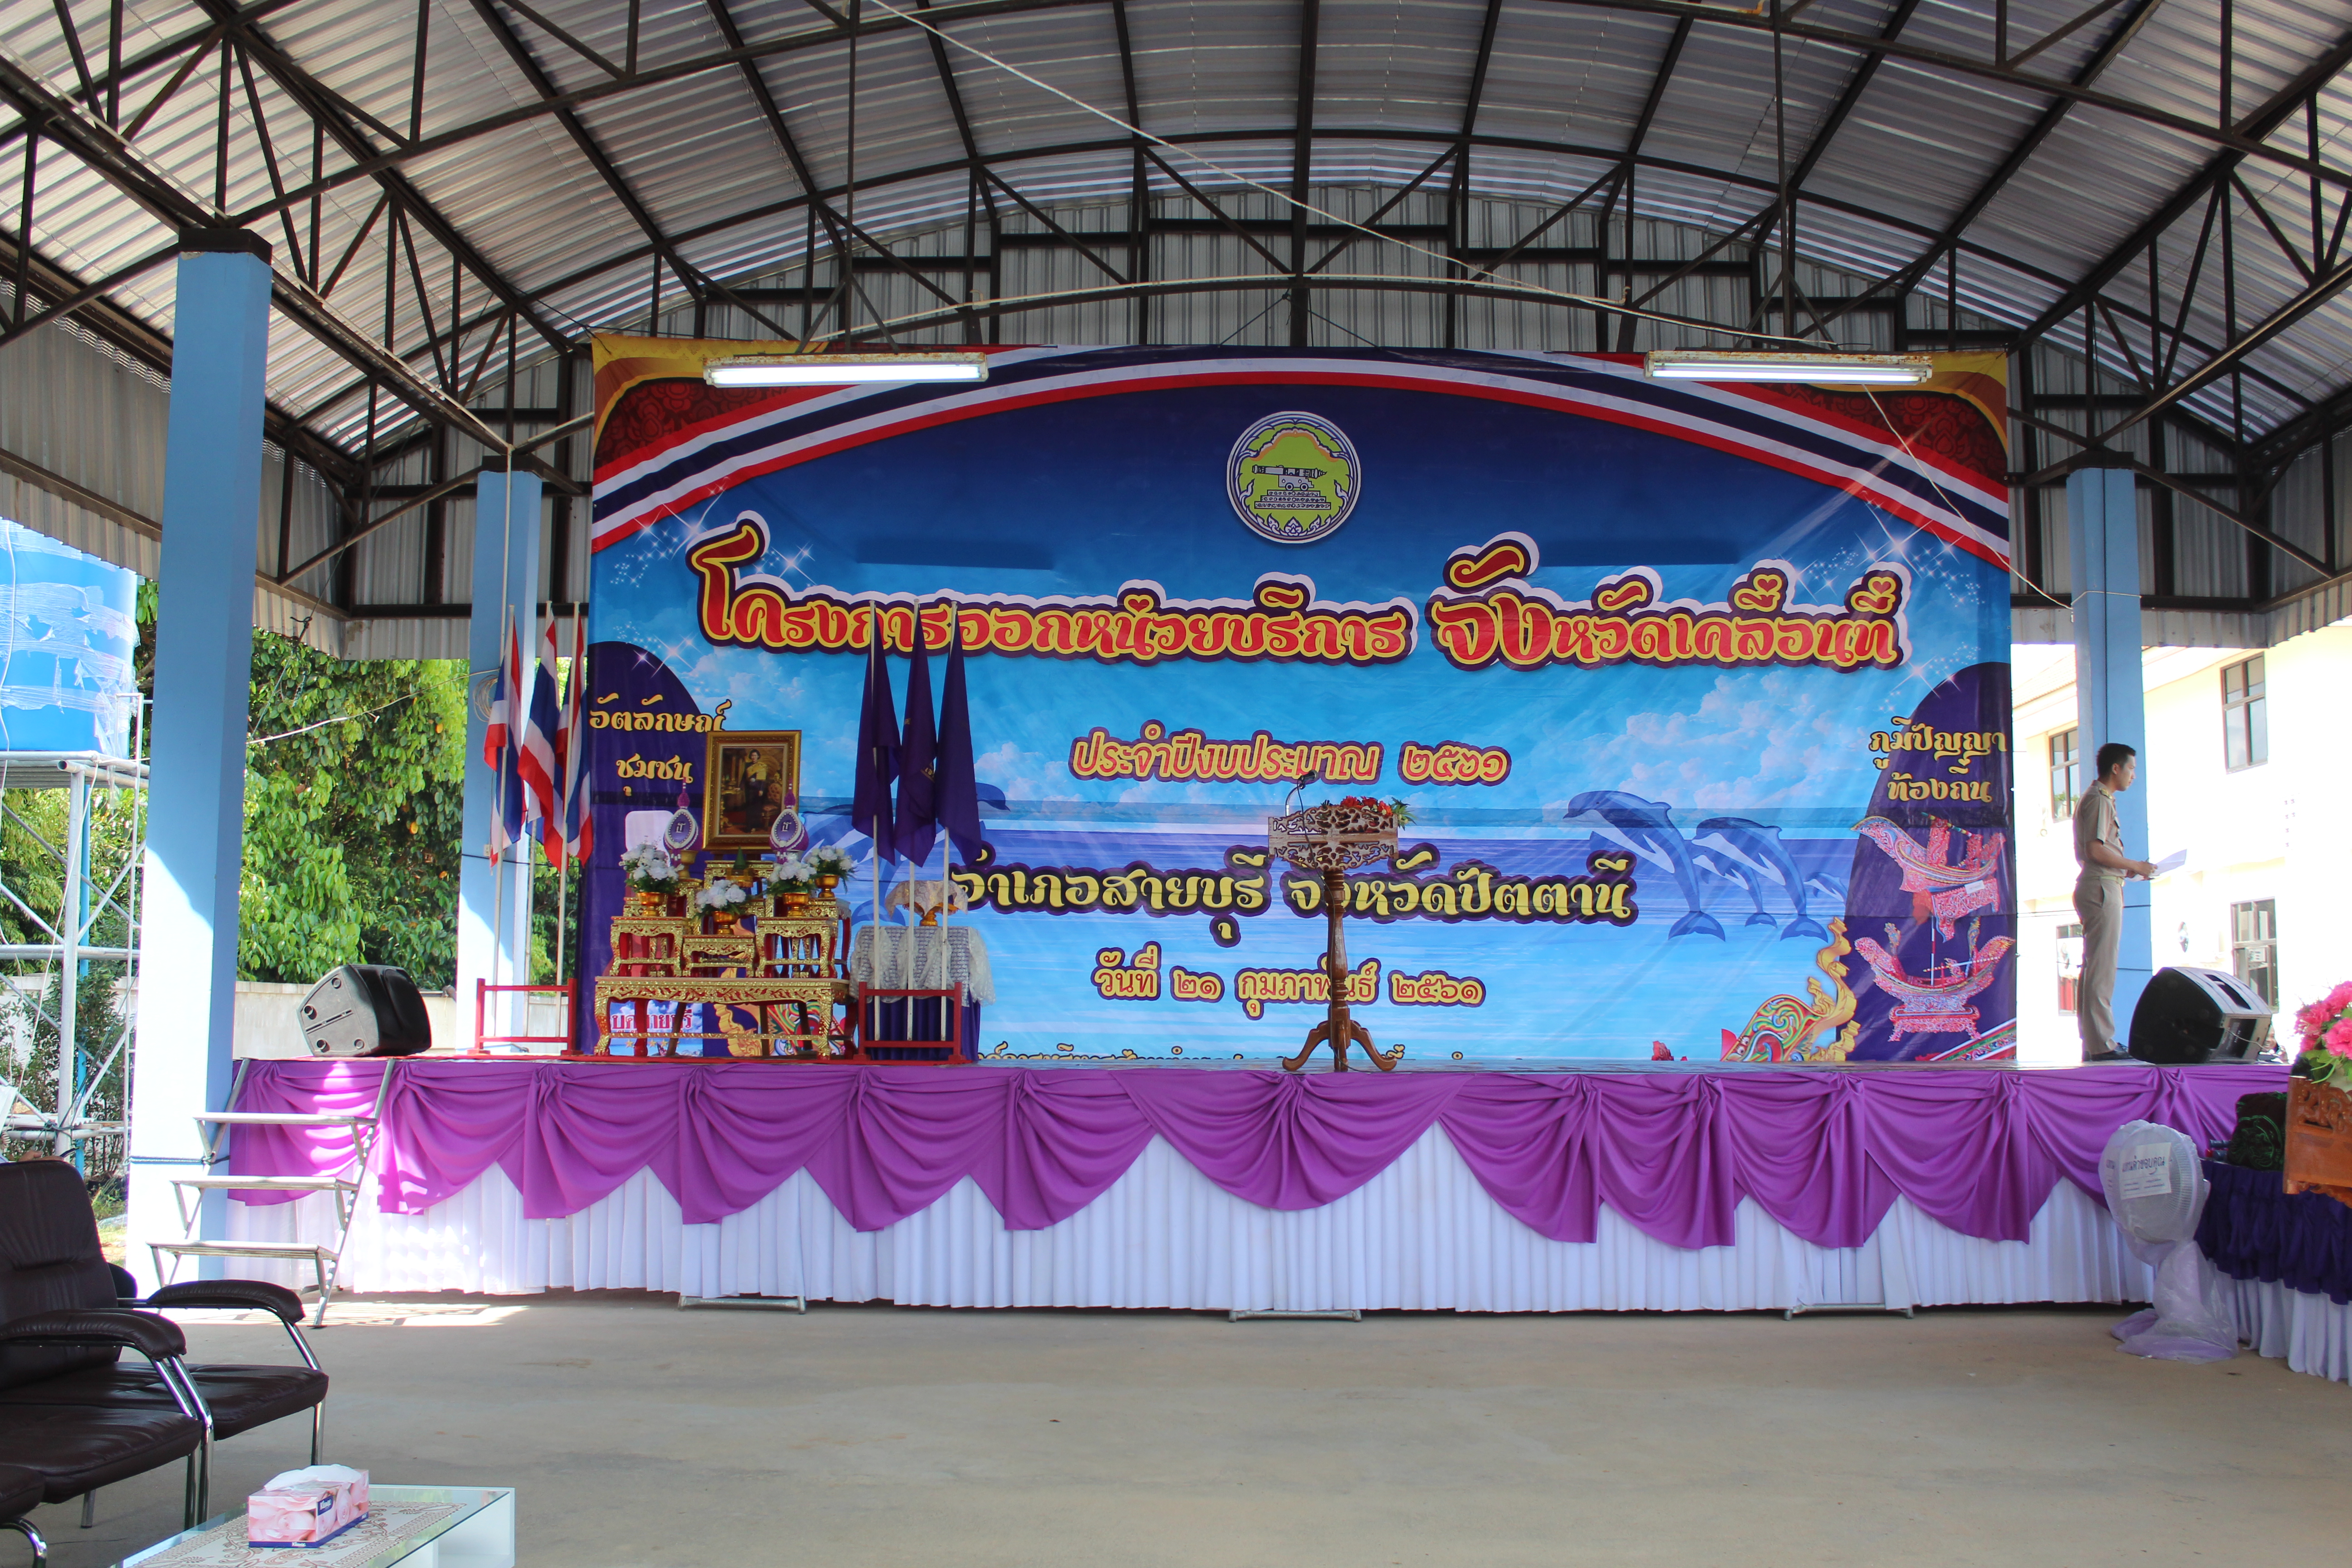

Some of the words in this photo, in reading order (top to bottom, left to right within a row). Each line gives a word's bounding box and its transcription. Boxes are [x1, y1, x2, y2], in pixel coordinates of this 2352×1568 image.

[691, 525, 1407, 662] โครงการออกหน่วยบริการ
[1432, 544, 1898, 668] จังหวัดเคลื่อนที่
[590, 692, 732, 732] อัตลักษณ์
[1073, 724, 1380, 780] ประจำปีงบประมาณ
[1401, 745, 1507, 782] ๒๕๖๑
[1868, 715, 2008, 769] ภูมิปัญญา
[616, 753, 693, 796] ชุมชน
[1887, 758, 1993, 803] ท้องถิ่น
[1288, 850, 1631, 919] จหวัดปัตตานี
[1094, 945, 1158, 997] วันที่
[1172, 969, 1221, 1000] ๒๑
[1238, 956, 1378, 1017] กุมภาพธ์
[1391, 973, 1483, 1004] ๒๕๖๑
